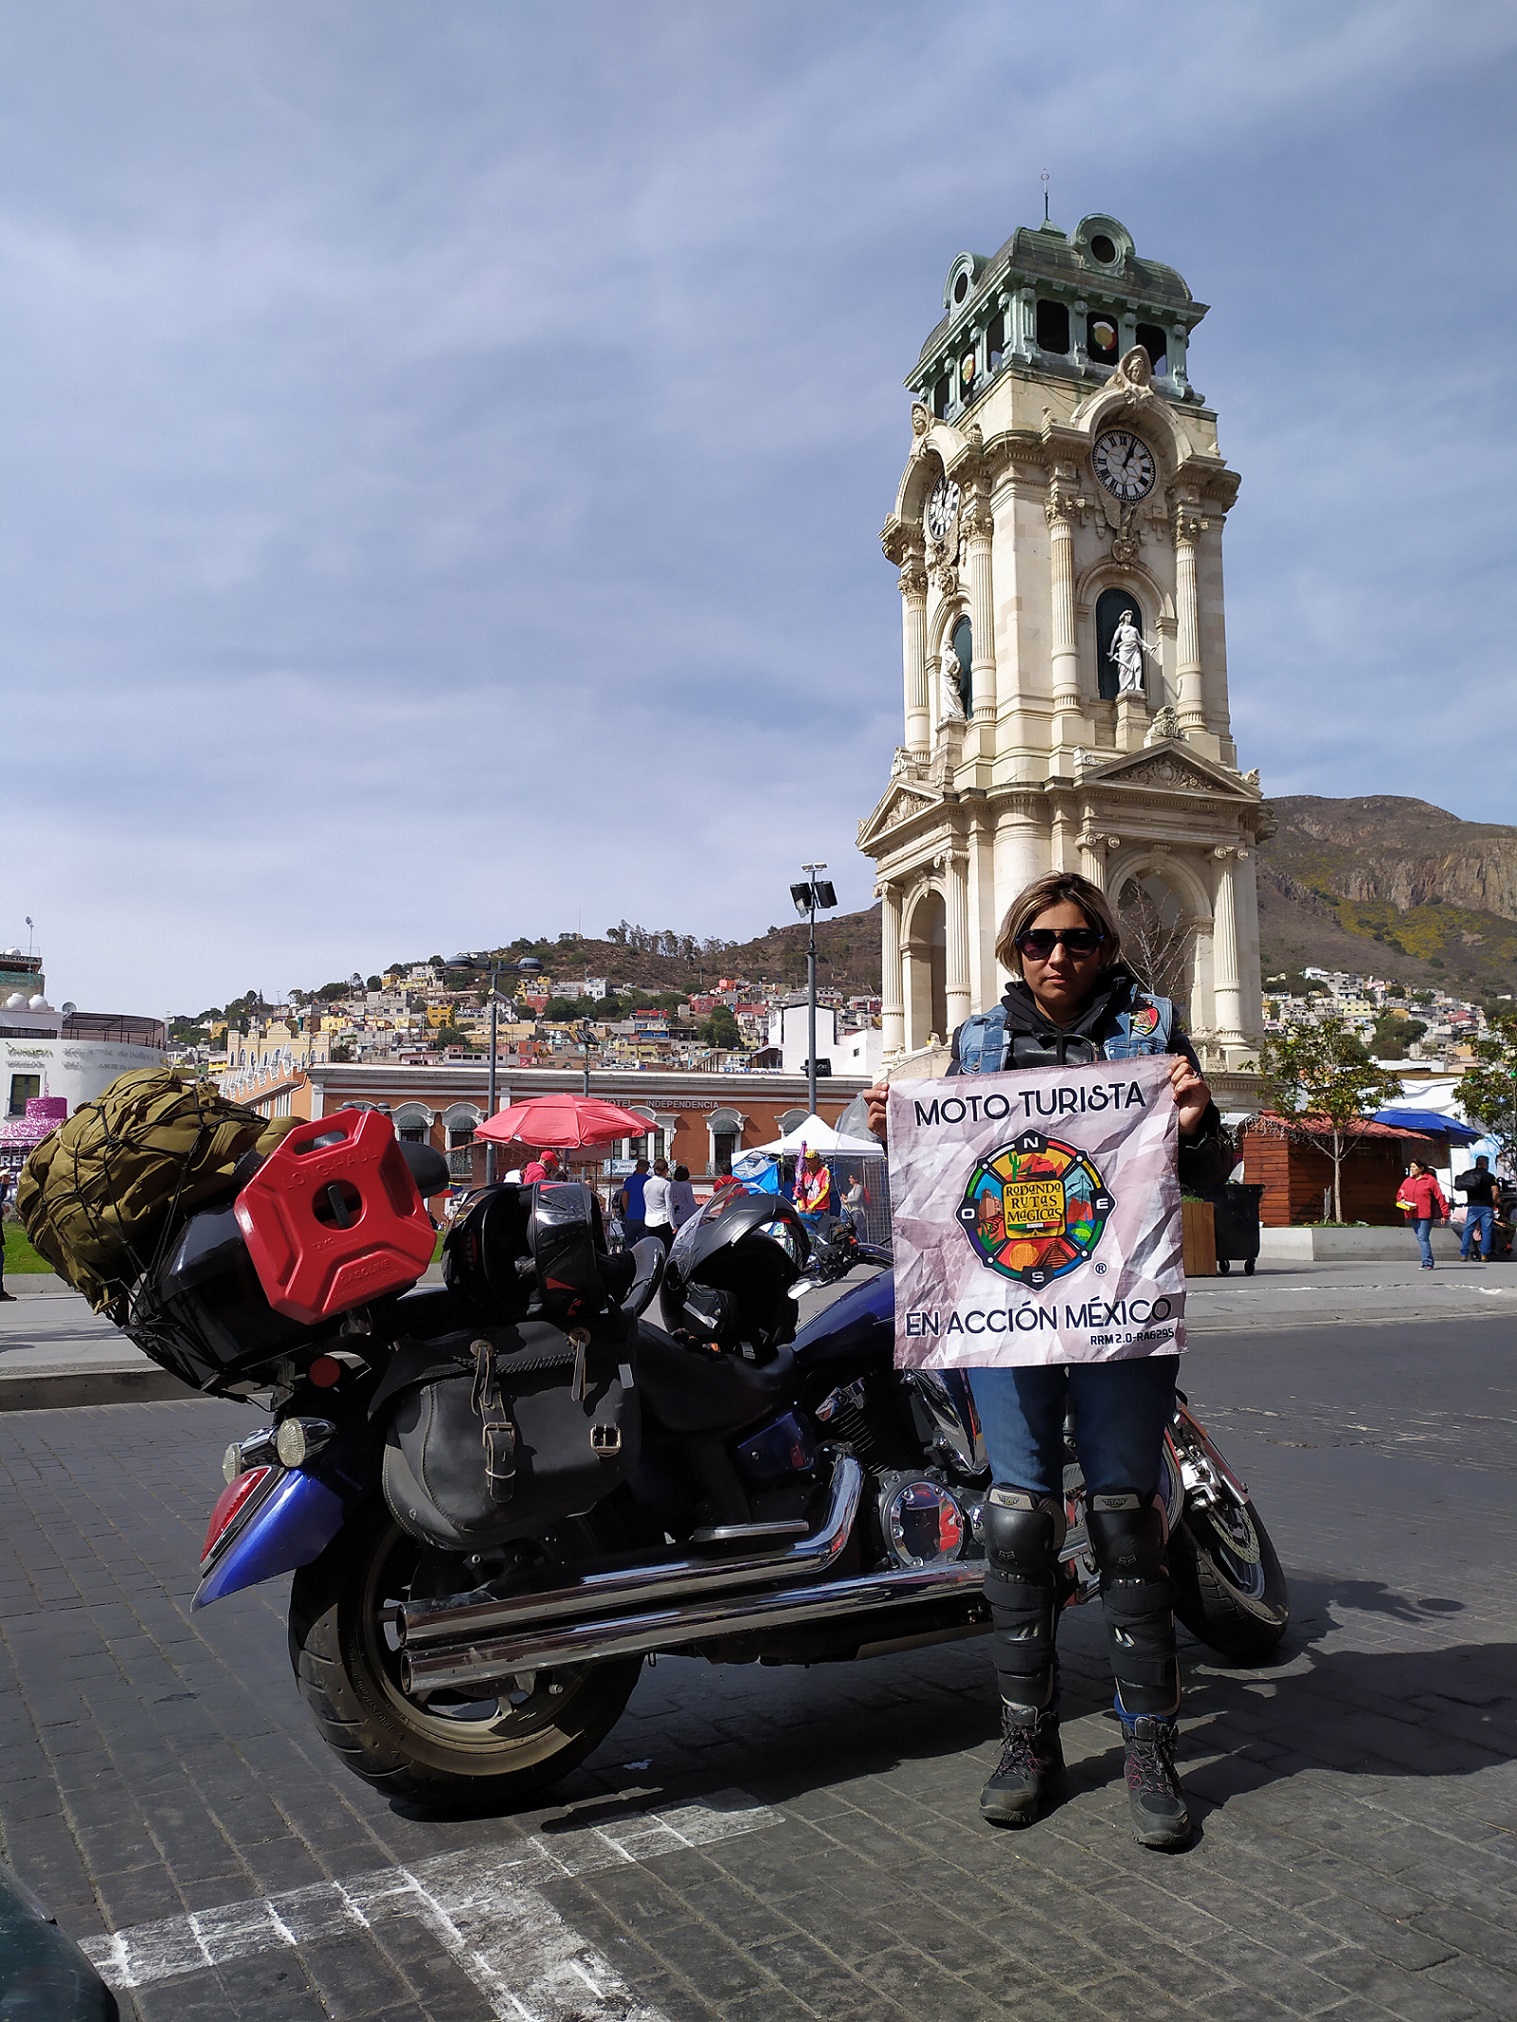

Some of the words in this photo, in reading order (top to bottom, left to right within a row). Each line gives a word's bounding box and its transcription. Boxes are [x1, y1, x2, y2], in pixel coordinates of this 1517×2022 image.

[645, 1100, 720, 1110] INDEPENDENCIA
[914, 1094, 1010, 1127] MOTO
[1018, 1081, 1146, 1117] TURISTA
[1023, 1137, 1039, 1148] N
[1096, 1198, 1109, 1210] E
[961, 1208, 976, 1220] O
[1031, 1271, 1045, 1284] S
[905, 1311, 939, 1336] EN
[947, 1300, 1057, 1334] ACCIÓN
[1065, 1295, 1172, 1330] MÉXICO
[1090, 1335, 1114, 1346] RRM
